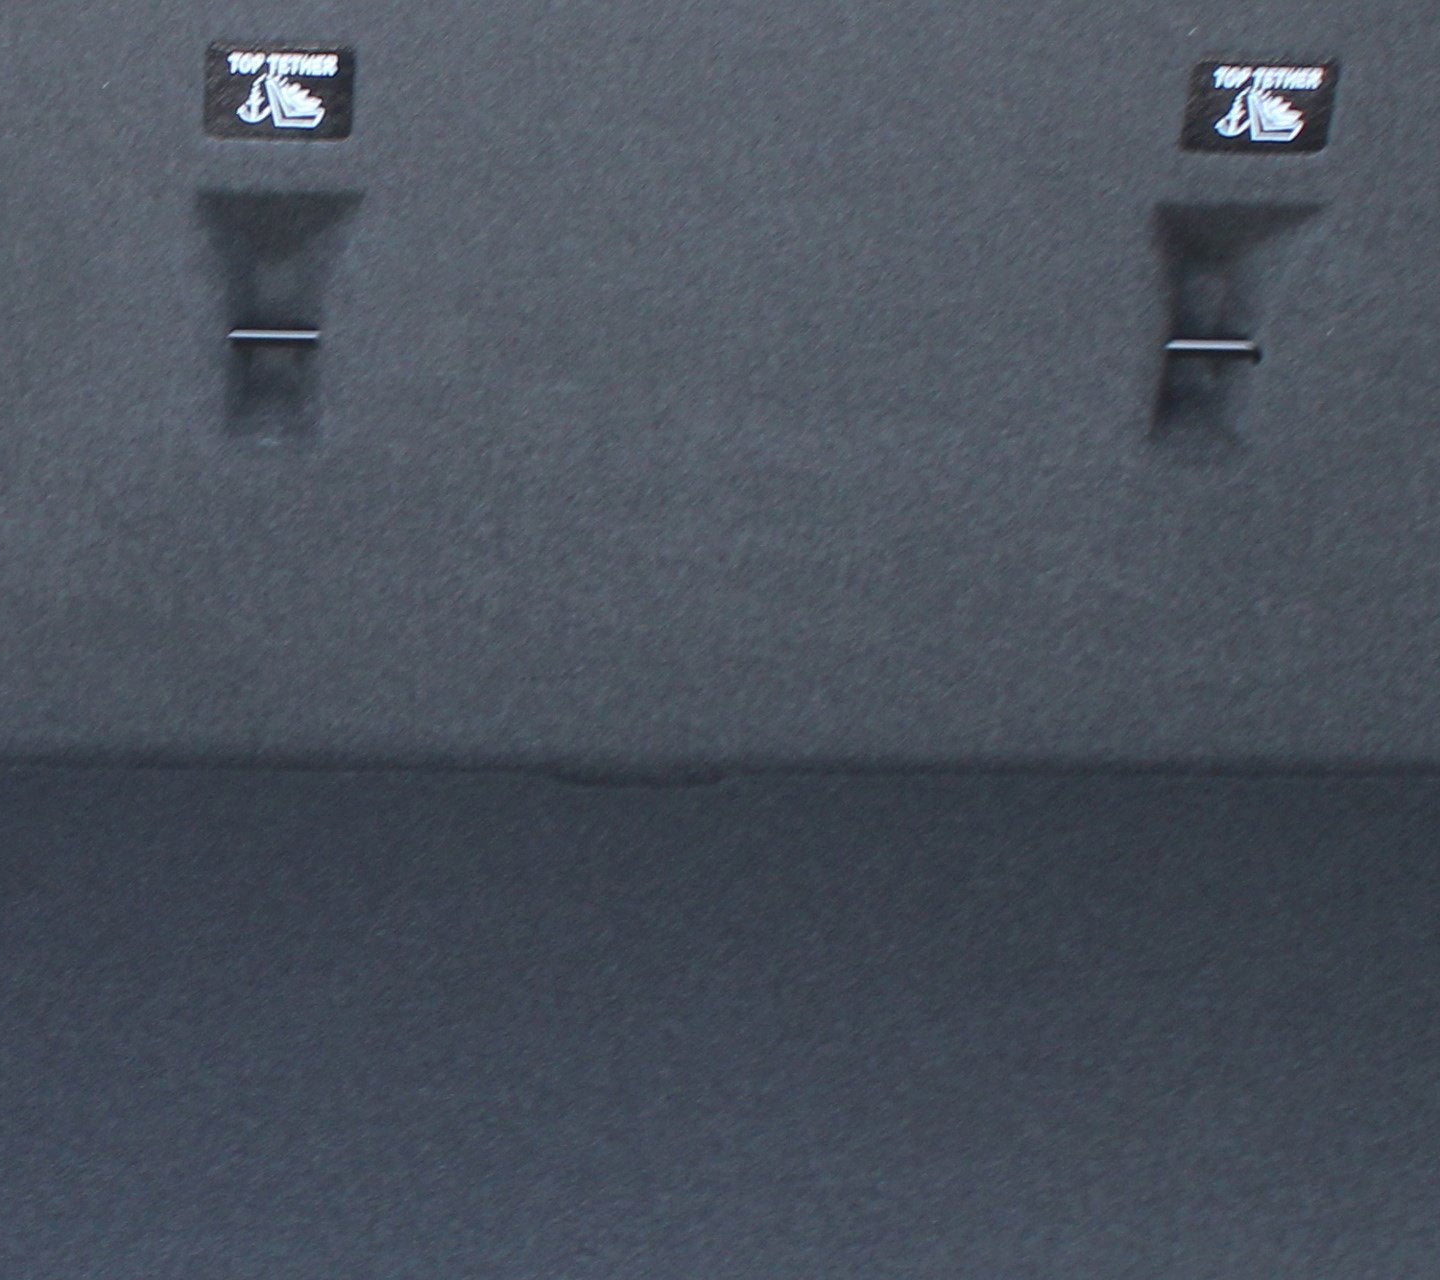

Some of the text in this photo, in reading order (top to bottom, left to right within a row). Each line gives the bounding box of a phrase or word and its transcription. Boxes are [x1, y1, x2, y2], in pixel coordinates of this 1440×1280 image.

[227, 51, 339, 76] TOP TETHER
[1213, 66, 1326, 89] TOP TETHER
